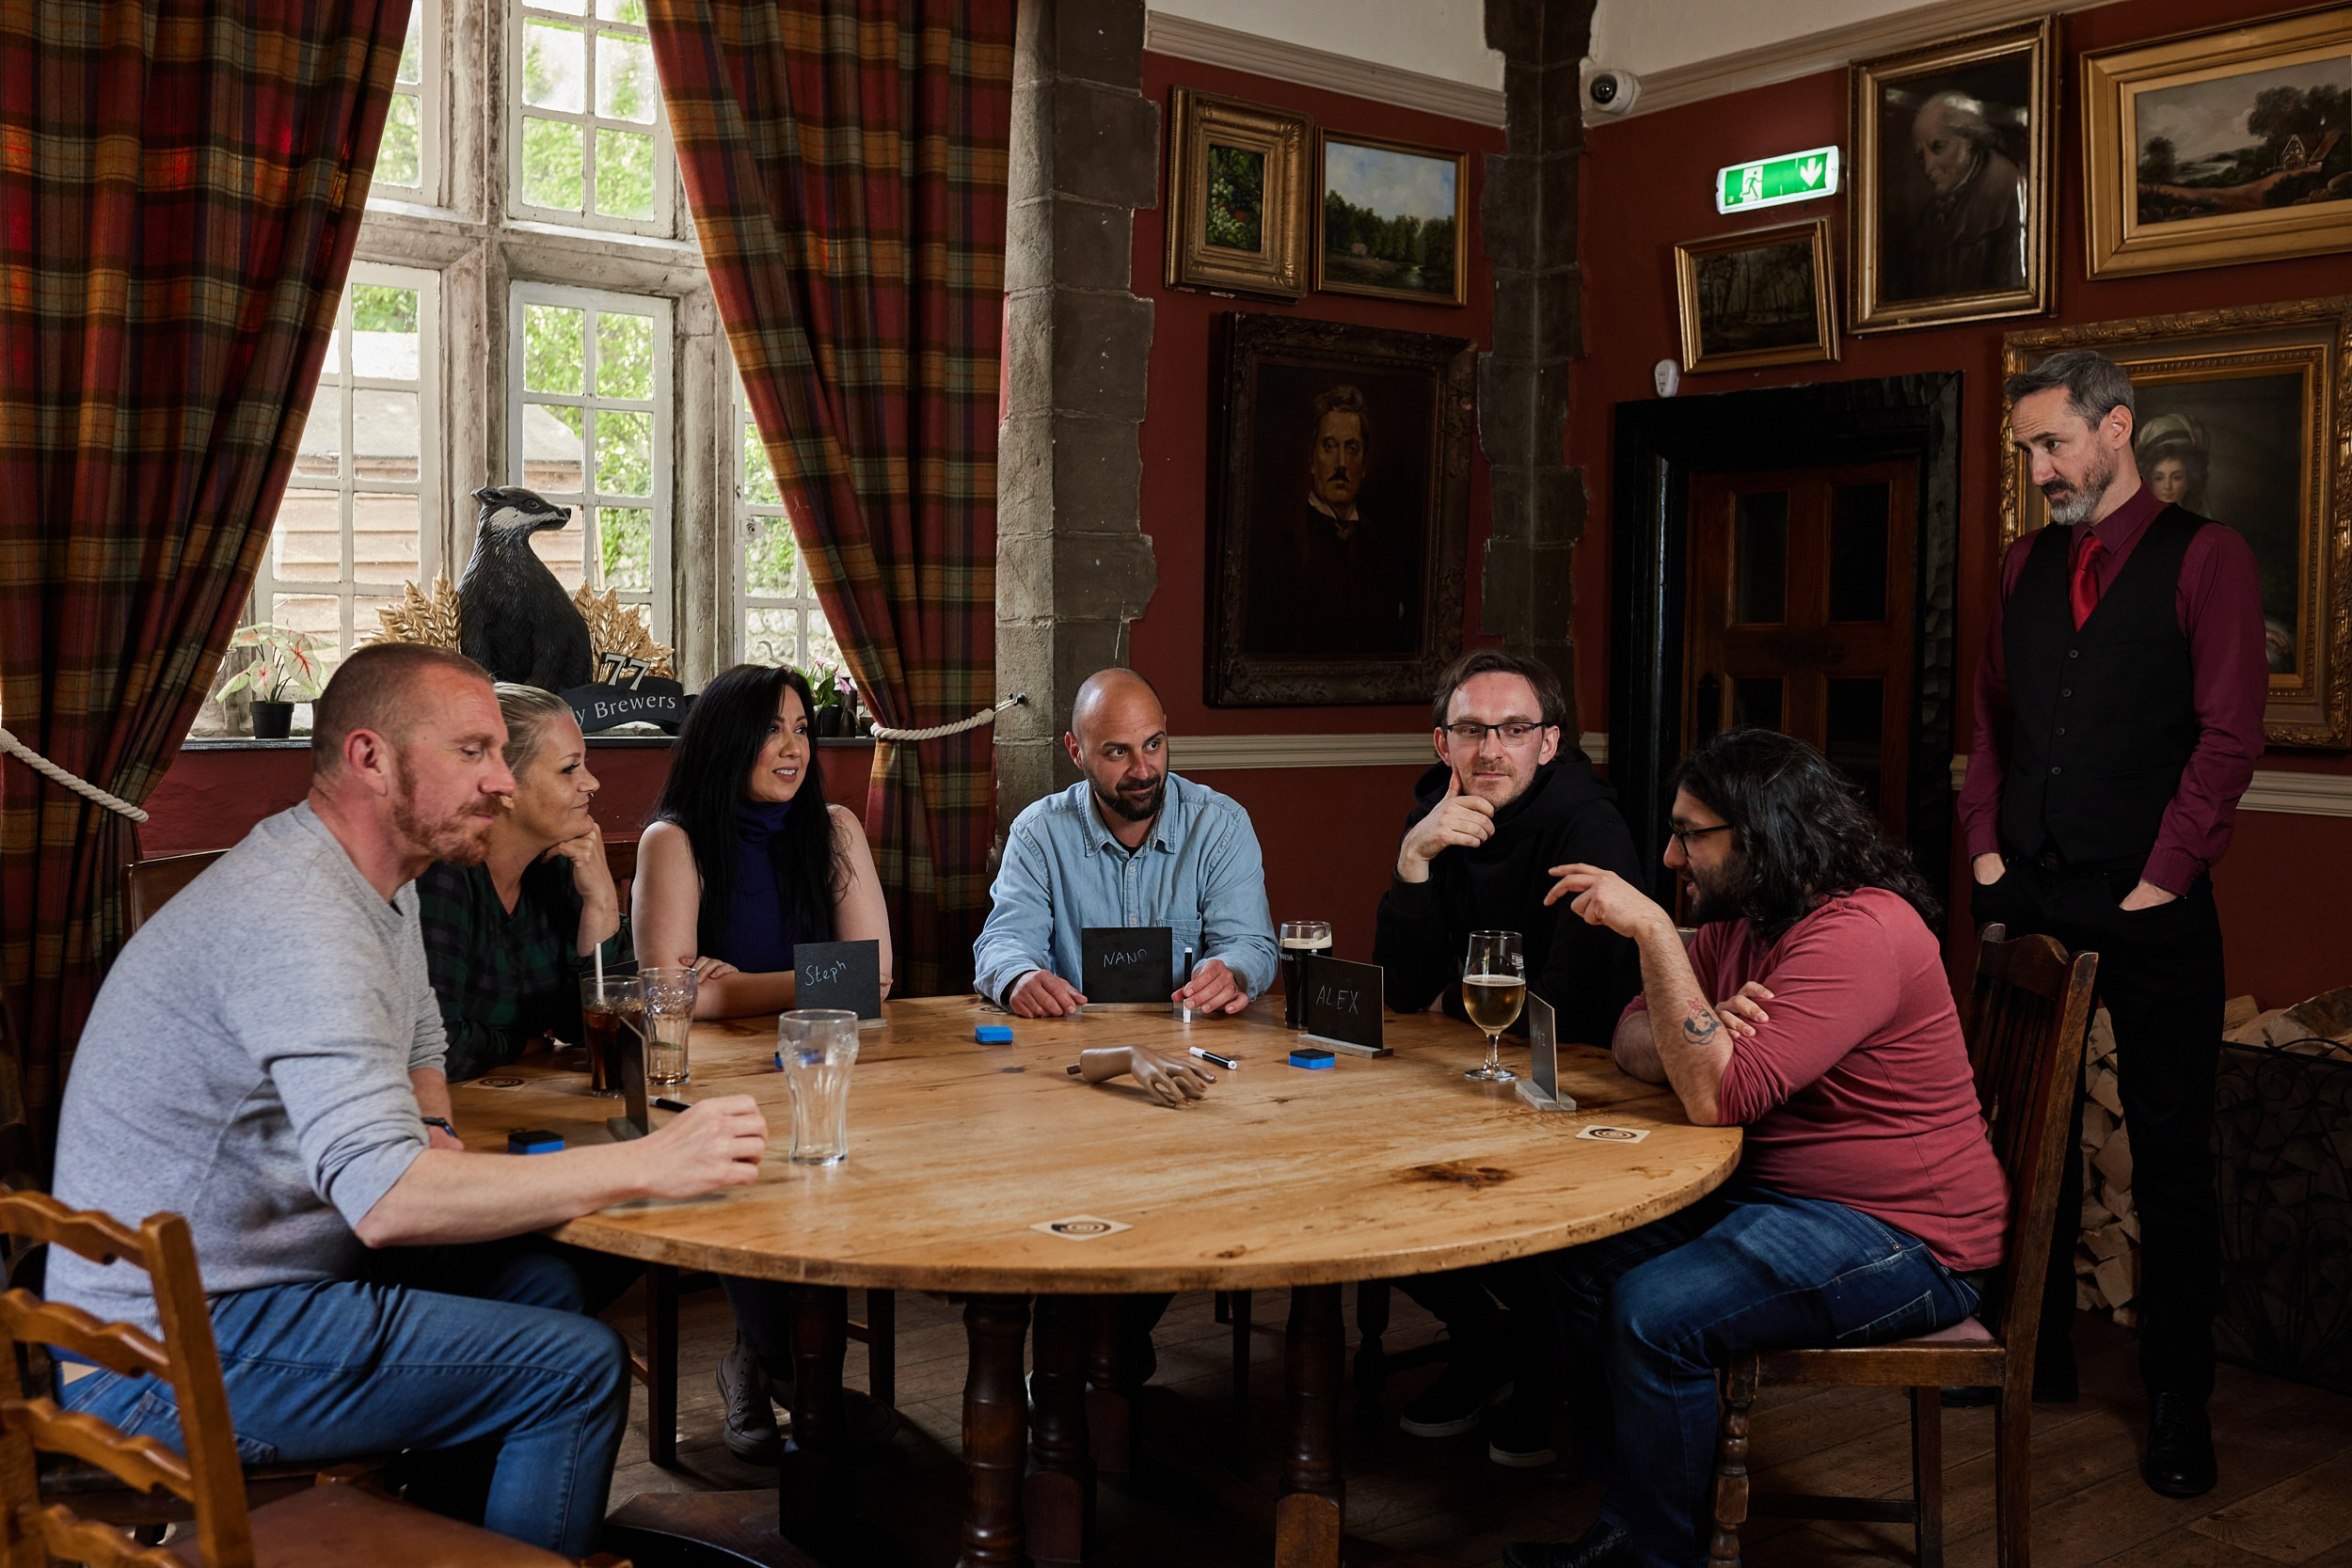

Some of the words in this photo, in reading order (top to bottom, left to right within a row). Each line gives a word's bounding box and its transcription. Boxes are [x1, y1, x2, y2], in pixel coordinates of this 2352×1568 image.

[604, 653, 651, 691] 77
[595, 695, 676, 719] Brewers
[804, 960, 848, 987] Steph
[1316, 985, 1359, 1016] ALEX
